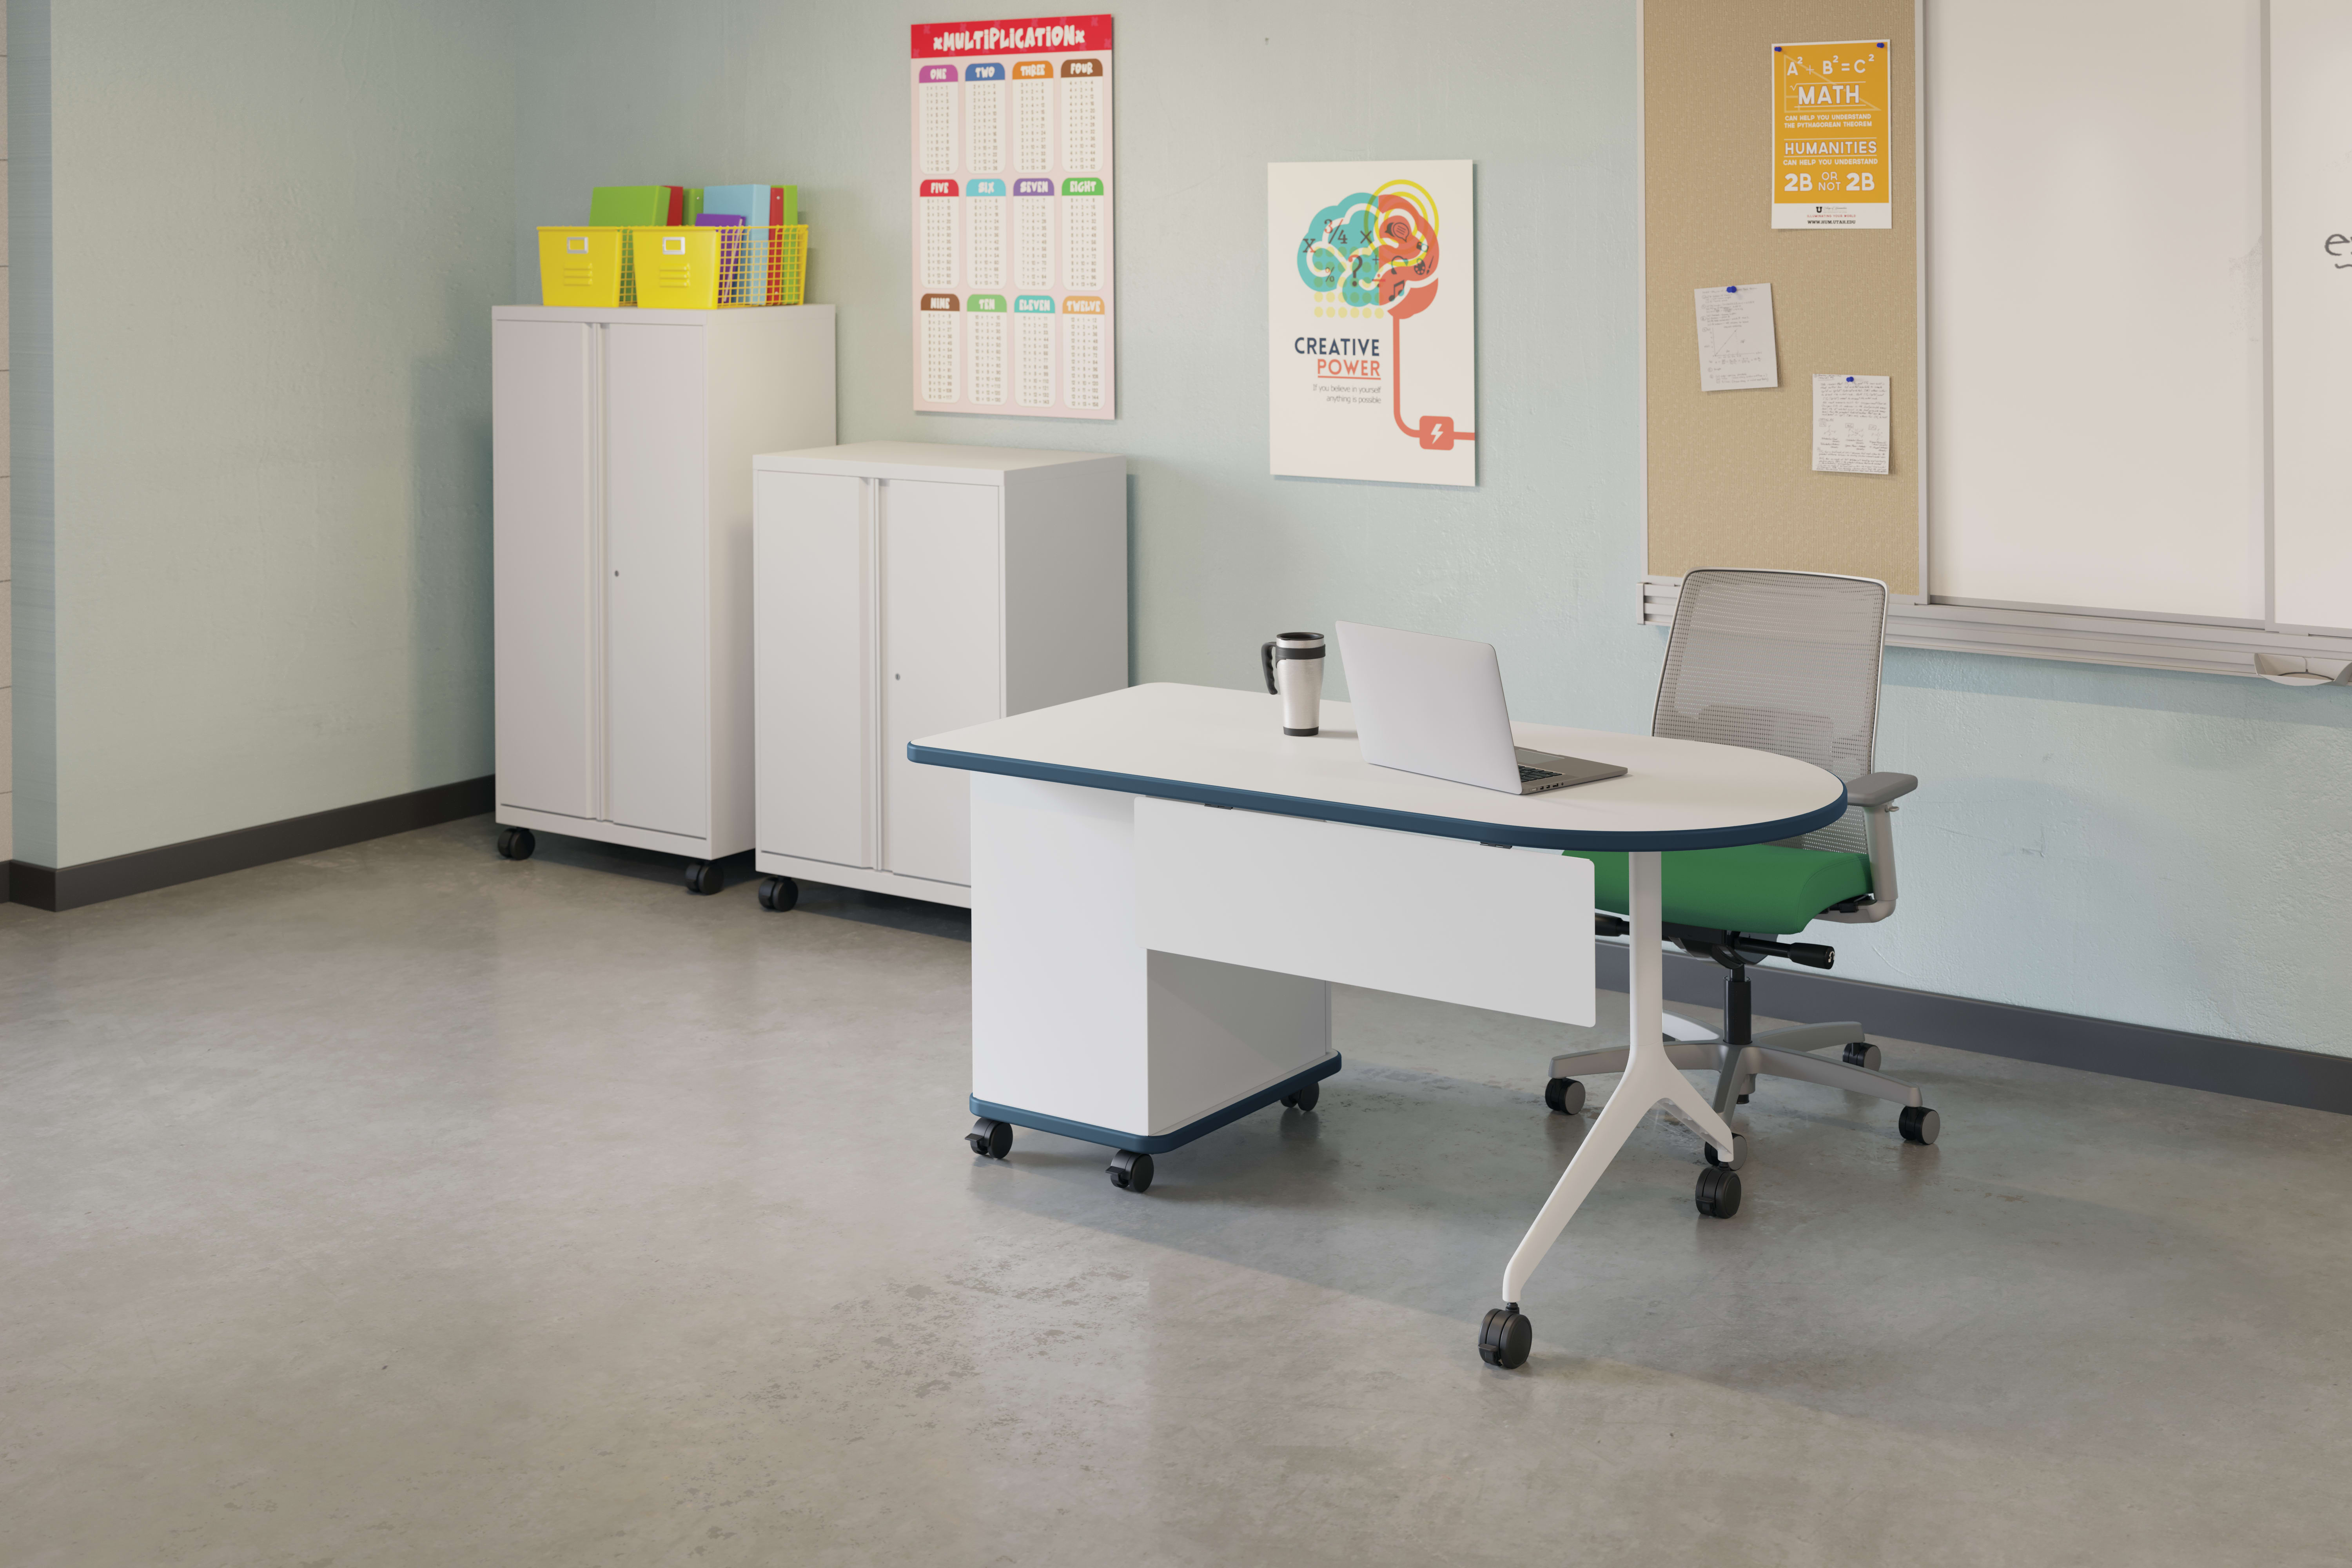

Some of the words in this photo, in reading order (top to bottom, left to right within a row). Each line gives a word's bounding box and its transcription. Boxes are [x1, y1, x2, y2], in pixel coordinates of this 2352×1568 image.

[930, 67, 947, 80] ONE
[975, 66, 995, 78] TWO
[1020, 64, 1045, 76] THREE
[1070, 62, 1094, 75] FOUR
[1798, 84, 1859, 105] MATH
[1785, 141, 1877, 155] HUMANITIES
[1784, 173, 1813, 191] 2B
[1821, 172, 1838, 180] OR
[1846, 172, 1875, 191] 2B
[931, 182, 949, 194] FIVE
[978, 181, 995, 194] SIX
[1020, 181, 1048, 193] SEVEN
[1070, 181, 1096, 192] EIGHT
[1818, 182, 1841, 191] NOT
[931, 298, 950, 309] NINE
[979, 299, 995, 310] TEN
[1019, 299, 1050, 311] ELEVEN
[1067, 300, 1100, 312] TWELVE
[1294, 337, 1380, 356] CREATIVE
[1318, 359, 1380, 376] POWER
[1327, 395, 1350, 404] anything
